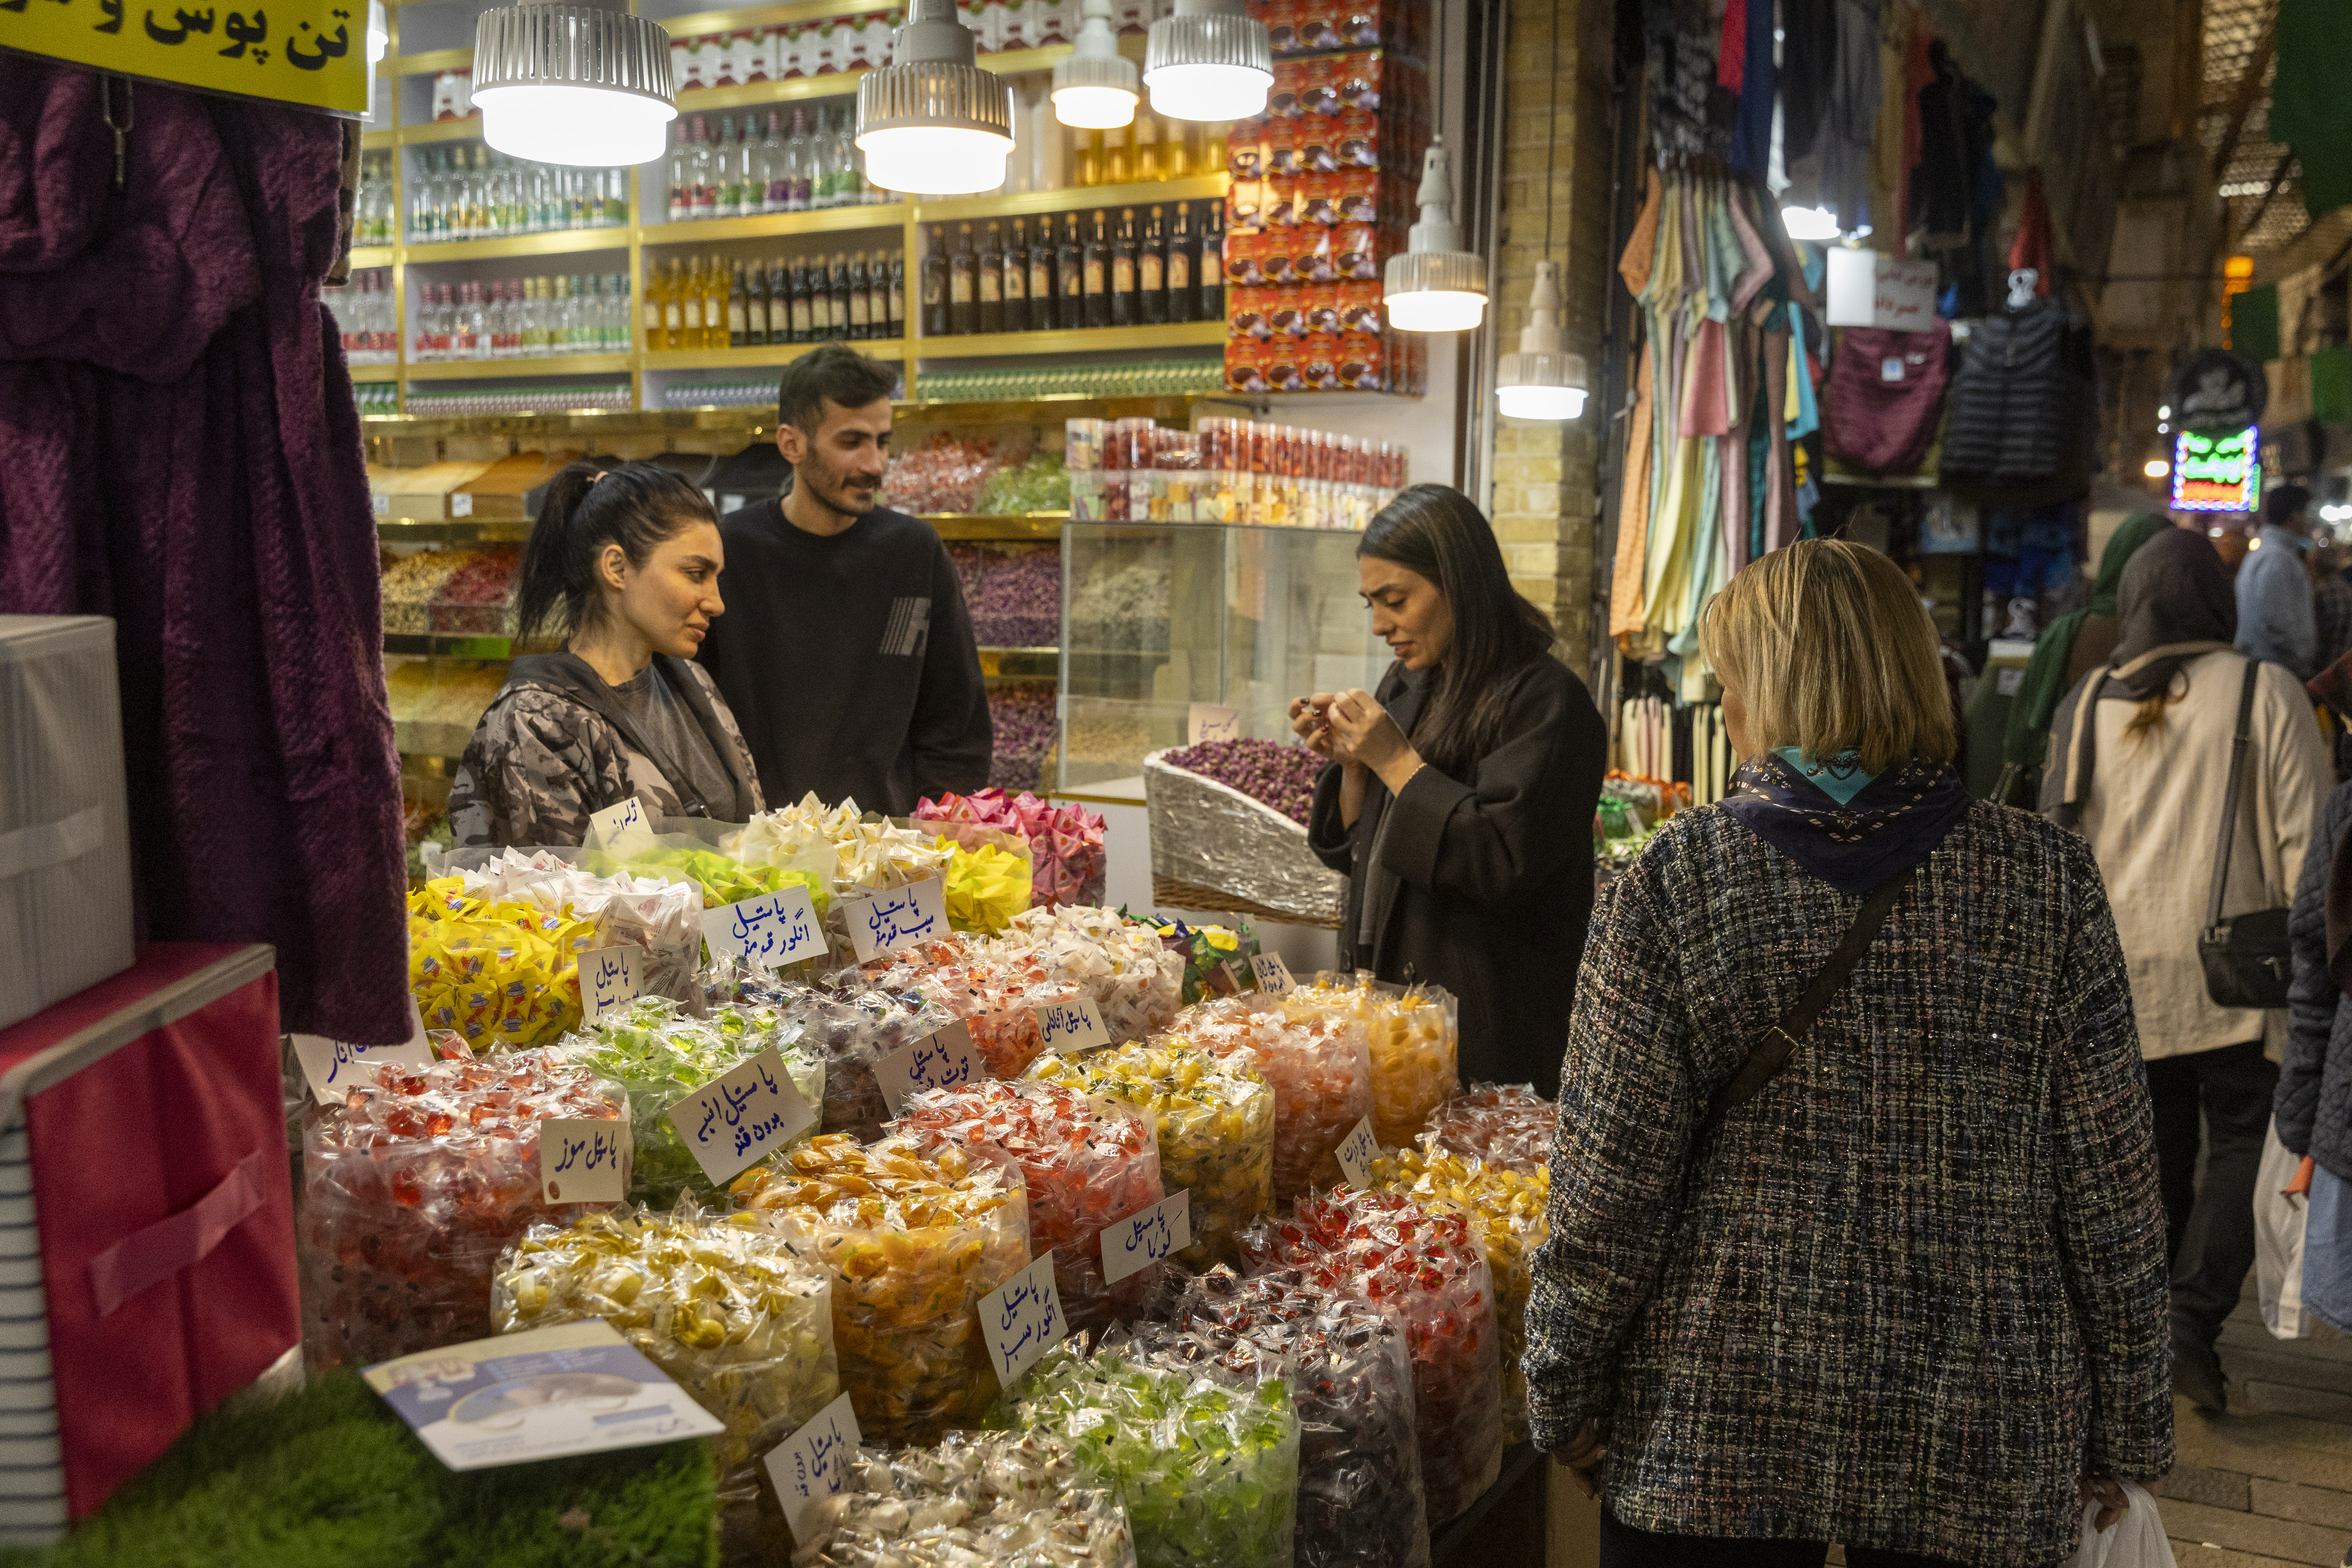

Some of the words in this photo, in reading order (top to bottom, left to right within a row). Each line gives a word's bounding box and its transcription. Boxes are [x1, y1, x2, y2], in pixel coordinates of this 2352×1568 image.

[286, 9, 351, 71] تن
[733, 898, 786, 939] پاستیل
[869, 887, 919, 929] پاستیل
[900, 915, 933, 938] سیب
[780, 908, 810, 955] انگور
[876, 923, 897, 947] قرمز
[596, 952, 628, 989] پاستیل
[596, 991, 615, 1016] سبز
[1042, 1005, 1063, 1042] آناناس
[1066, 1005, 1091, 1034] پاستیل
[910, 1034, 949, 1080] پاستیل
[941, 1056, 969, 1085] توت
[722, 1063, 778, 1126] پاستیل
[698, 1097, 722, 1142] انبه
[753, 1112, 784, 1141] بدون
[555, 1138, 585, 1172] موز
[586, 1130, 617, 1170] پاستیل
[735, 1126, 751, 1157] قند
[1126, 1206, 1165, 1251] پاستیل
[1148, 1210, 1182, 1258] کوکا
[1002, 1272, 1039, 1330] پاستیل
[1037, 1286, 1057, 1343] انگور
[1001, 1323, 1031, 1374] سبز
